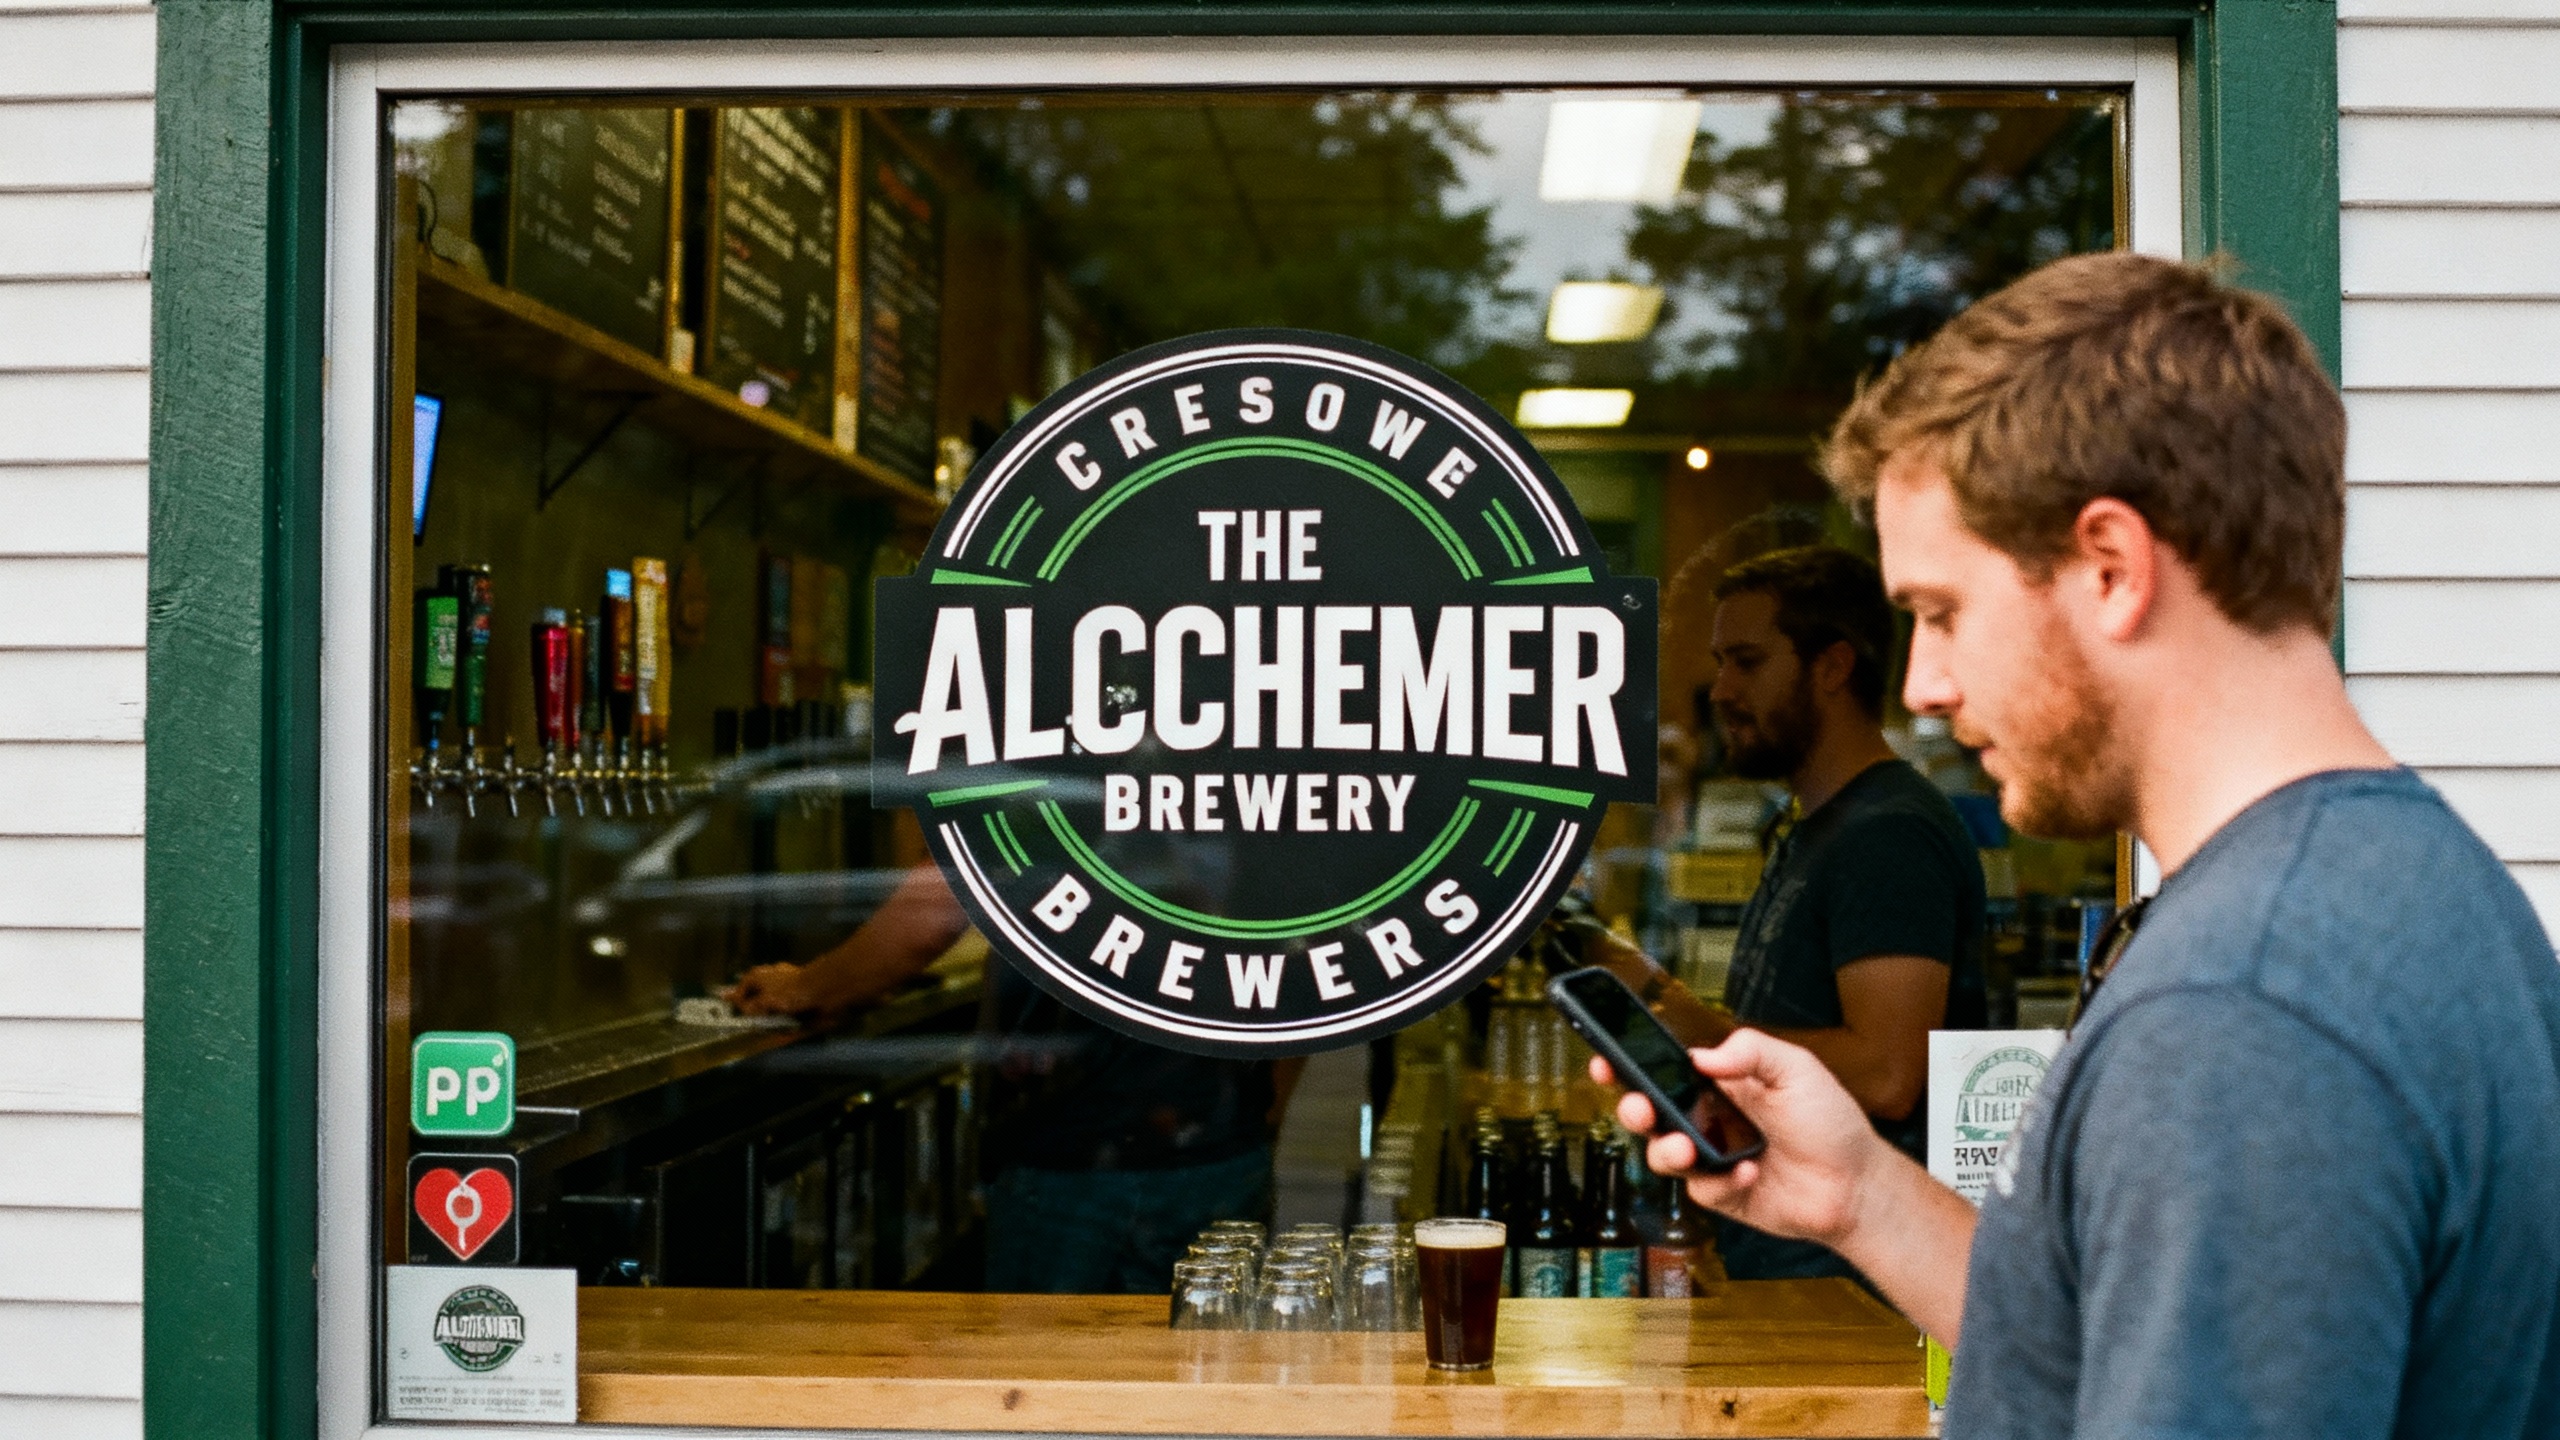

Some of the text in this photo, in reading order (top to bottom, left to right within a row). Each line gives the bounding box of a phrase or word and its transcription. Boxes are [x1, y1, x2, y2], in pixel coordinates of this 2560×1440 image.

[1055, 376, 1478, 499] CRESOWE
[1198, 510, 1322, 581] THE
[894, 605, 1628, 777] ALCCHEMER
[1104, 774, 1416, 832] BREWERY
[1031, 873, 1480, 1009] BREWERS
